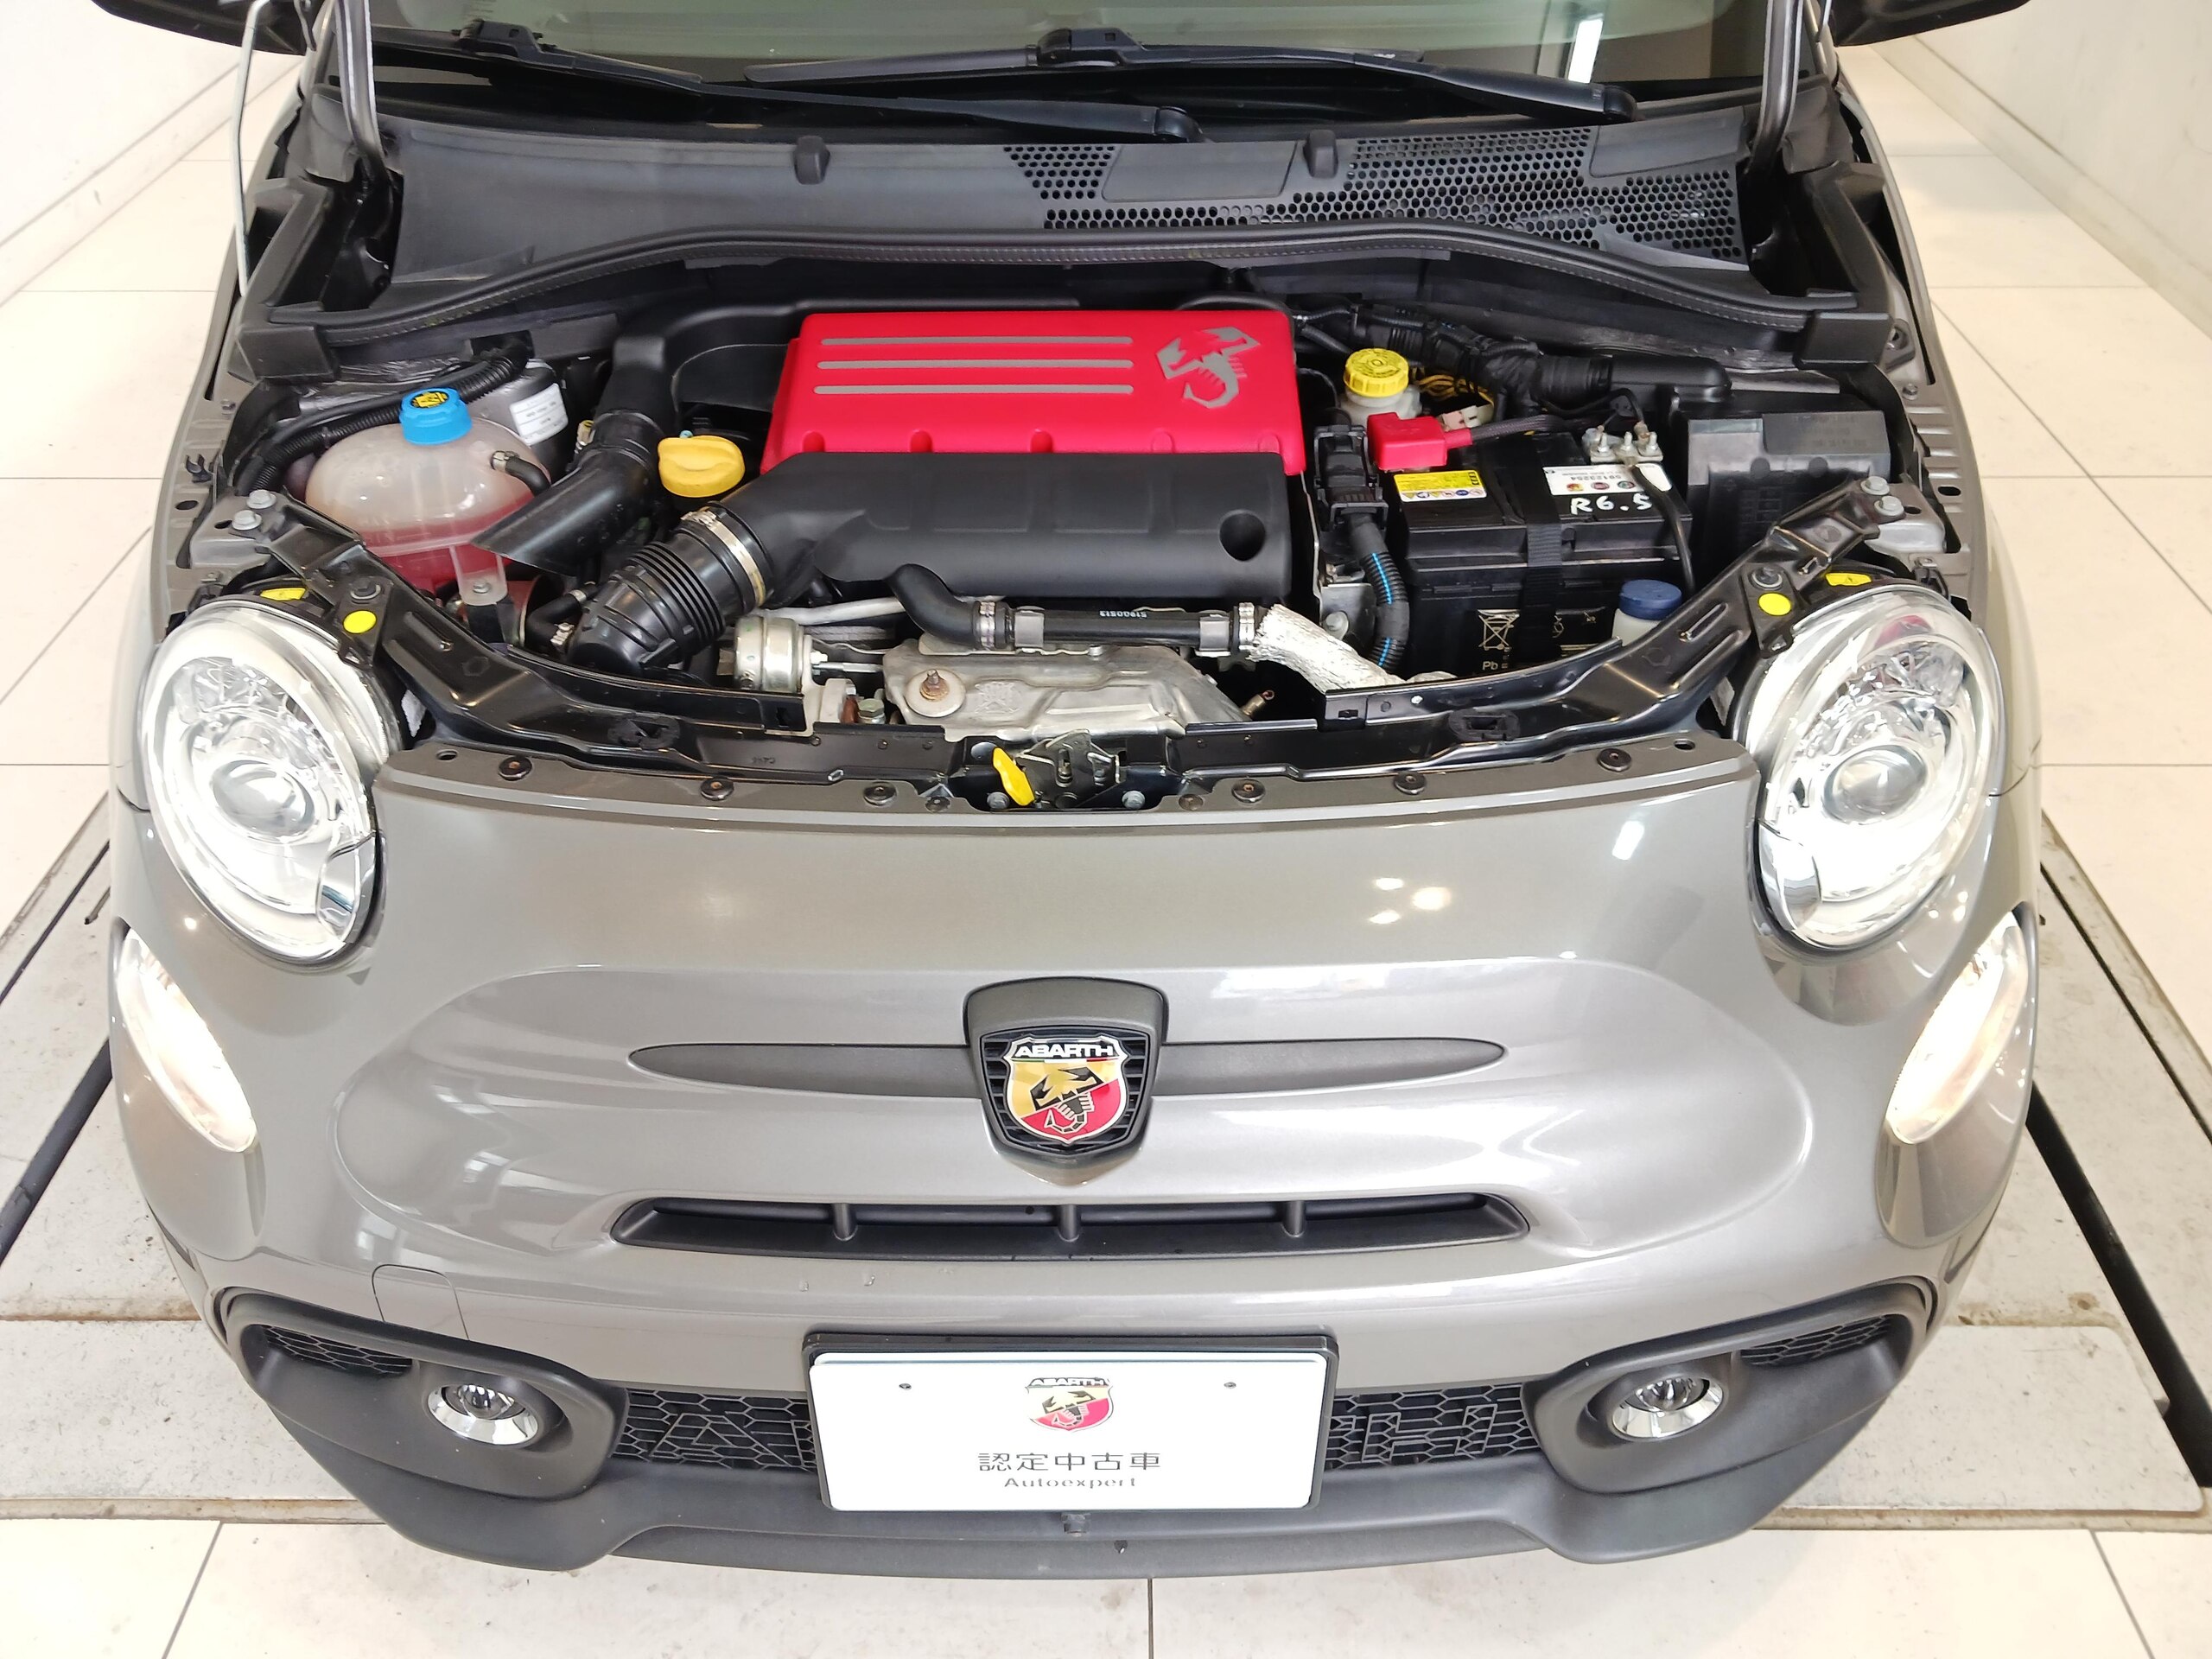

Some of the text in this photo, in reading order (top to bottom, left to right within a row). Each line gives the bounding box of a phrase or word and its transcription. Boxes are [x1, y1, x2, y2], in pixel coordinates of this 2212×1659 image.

[1570, 493, 1652, 515] R6.5
[1482, 660, 1498, 671] Pb
[1014, 1043, 1115, 1058] ABARTH
[1028, 1376, 1109, 1387] ABARTH
[977, 1452, 1161, 1471] 認定中古車
[1004, 1477, 1136, 1489] Autoexpert
